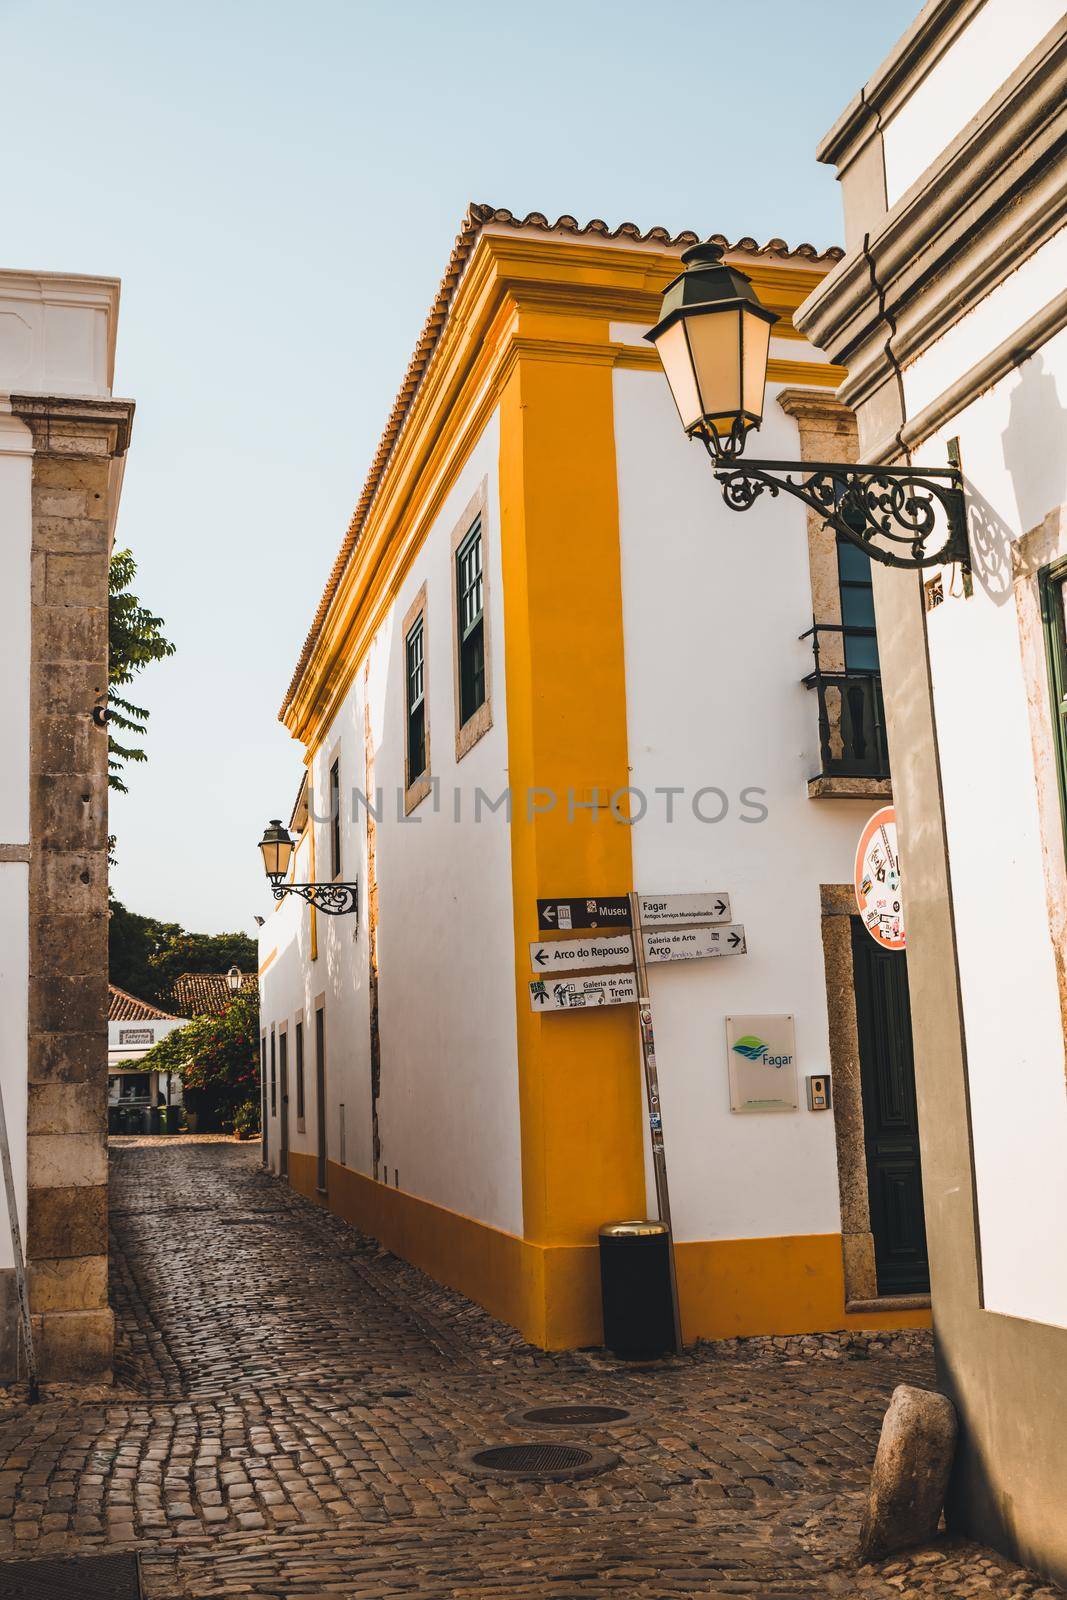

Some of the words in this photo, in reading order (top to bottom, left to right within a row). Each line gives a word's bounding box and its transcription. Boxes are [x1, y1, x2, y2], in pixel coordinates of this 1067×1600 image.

[599, 906, 627, 916] Museu
[643, 902, 667, 912] Fagar
[647, 936, 671, 944] Galeria
[672, 935, 680, 943] de
[554, 950, 575, 959] Arco
[577, 948, 589, 957] do
[591, 946, 629, 957] Repouso
[649, 946, 671, 955] Arco
[583, 980, 606, 988] Galeria
[609, 988, 634, 997] Trem
[762, 1054, 792, 1068] Fagar
